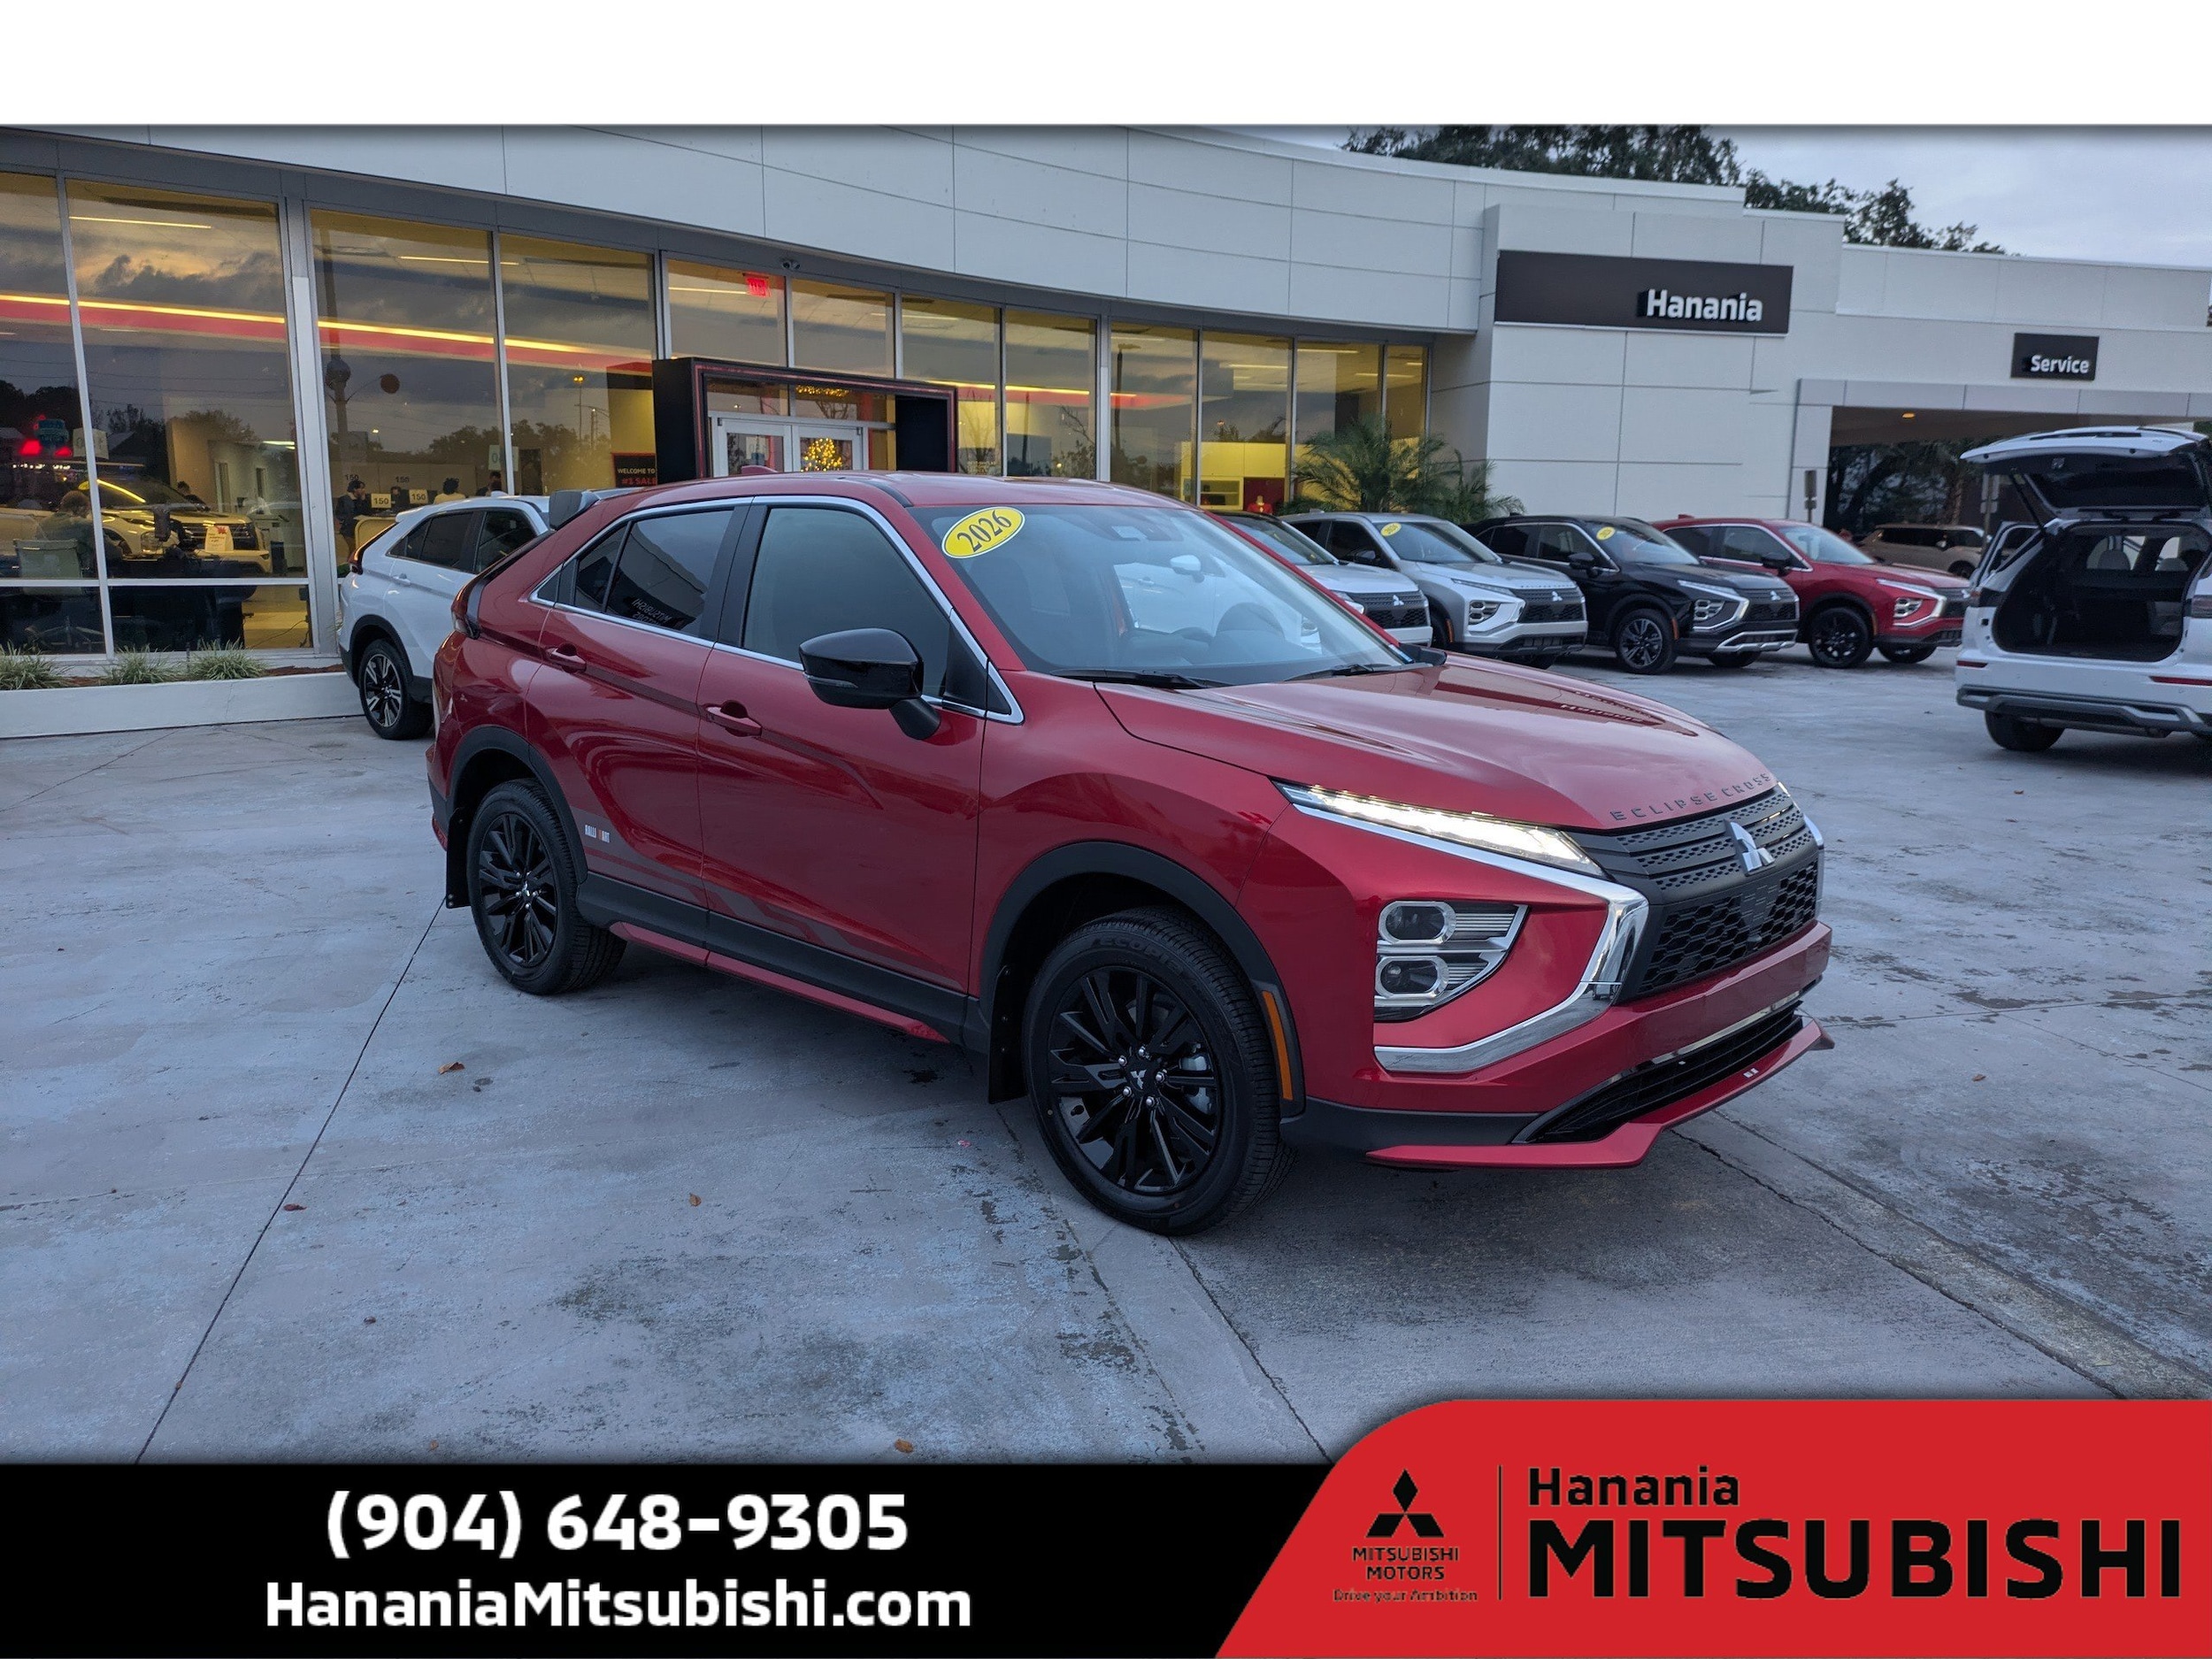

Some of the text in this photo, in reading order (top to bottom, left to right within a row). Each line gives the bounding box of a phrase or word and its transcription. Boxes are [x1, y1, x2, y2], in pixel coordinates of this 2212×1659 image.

[1647, 288, 1763, 321] Hanania
[2031, 355, 2090, 373] Service
[411, 493, 426, 502] 150
[956, 510, 1011, 552] 2026
[1609, 772, 1771, 821] ECLIPSE CROSS
